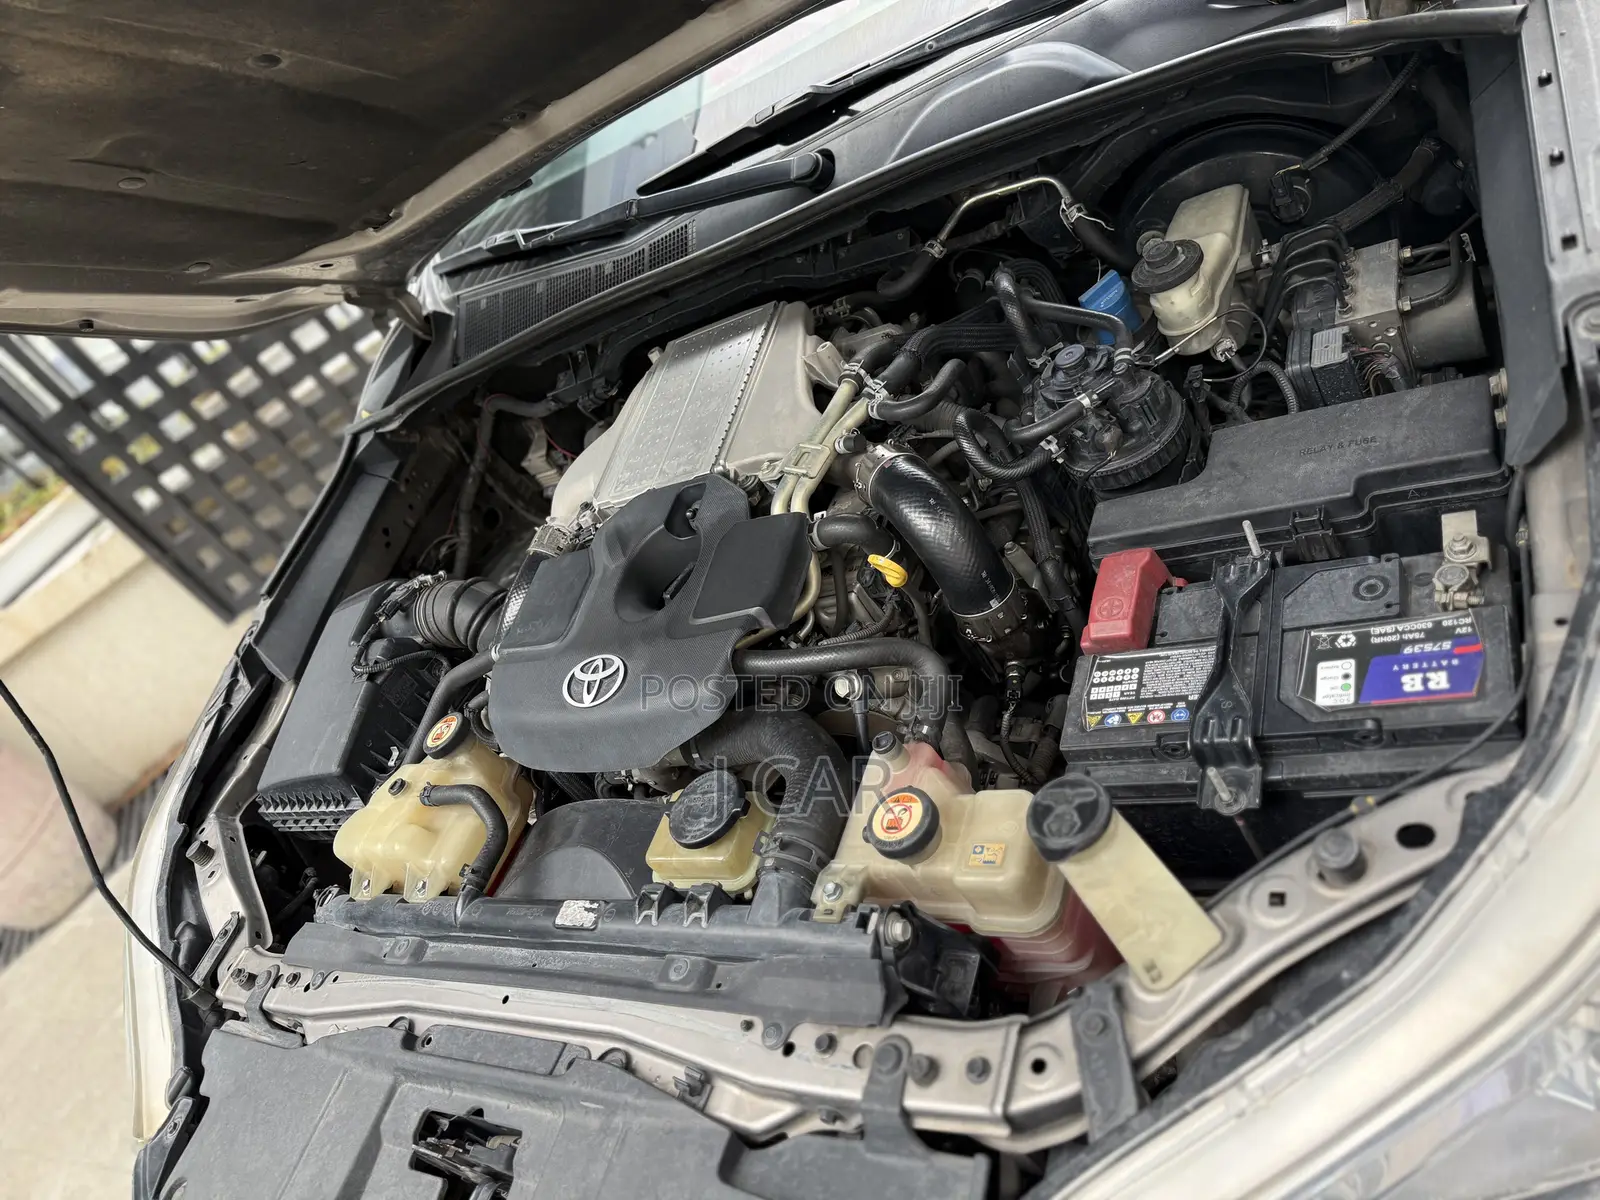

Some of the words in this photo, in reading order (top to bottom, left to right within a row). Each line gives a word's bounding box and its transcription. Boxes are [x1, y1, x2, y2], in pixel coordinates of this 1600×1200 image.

[1299, 444, 1333, 456] RELAY
[1397, 621, 1433, 631] 630CCA
[1442, 616, 1472, 627] RC120
[1370, 625, 1396, 635] (SAE)
[1455, 626, 1472, 635] 12V
[1370, 633, 1400, 644] (20HR)
[1402, 631, 1425, 642] 75Ah
[1393, 659, 1458, 671] BATTERY
[1401, 671, 1450, 692] RB
